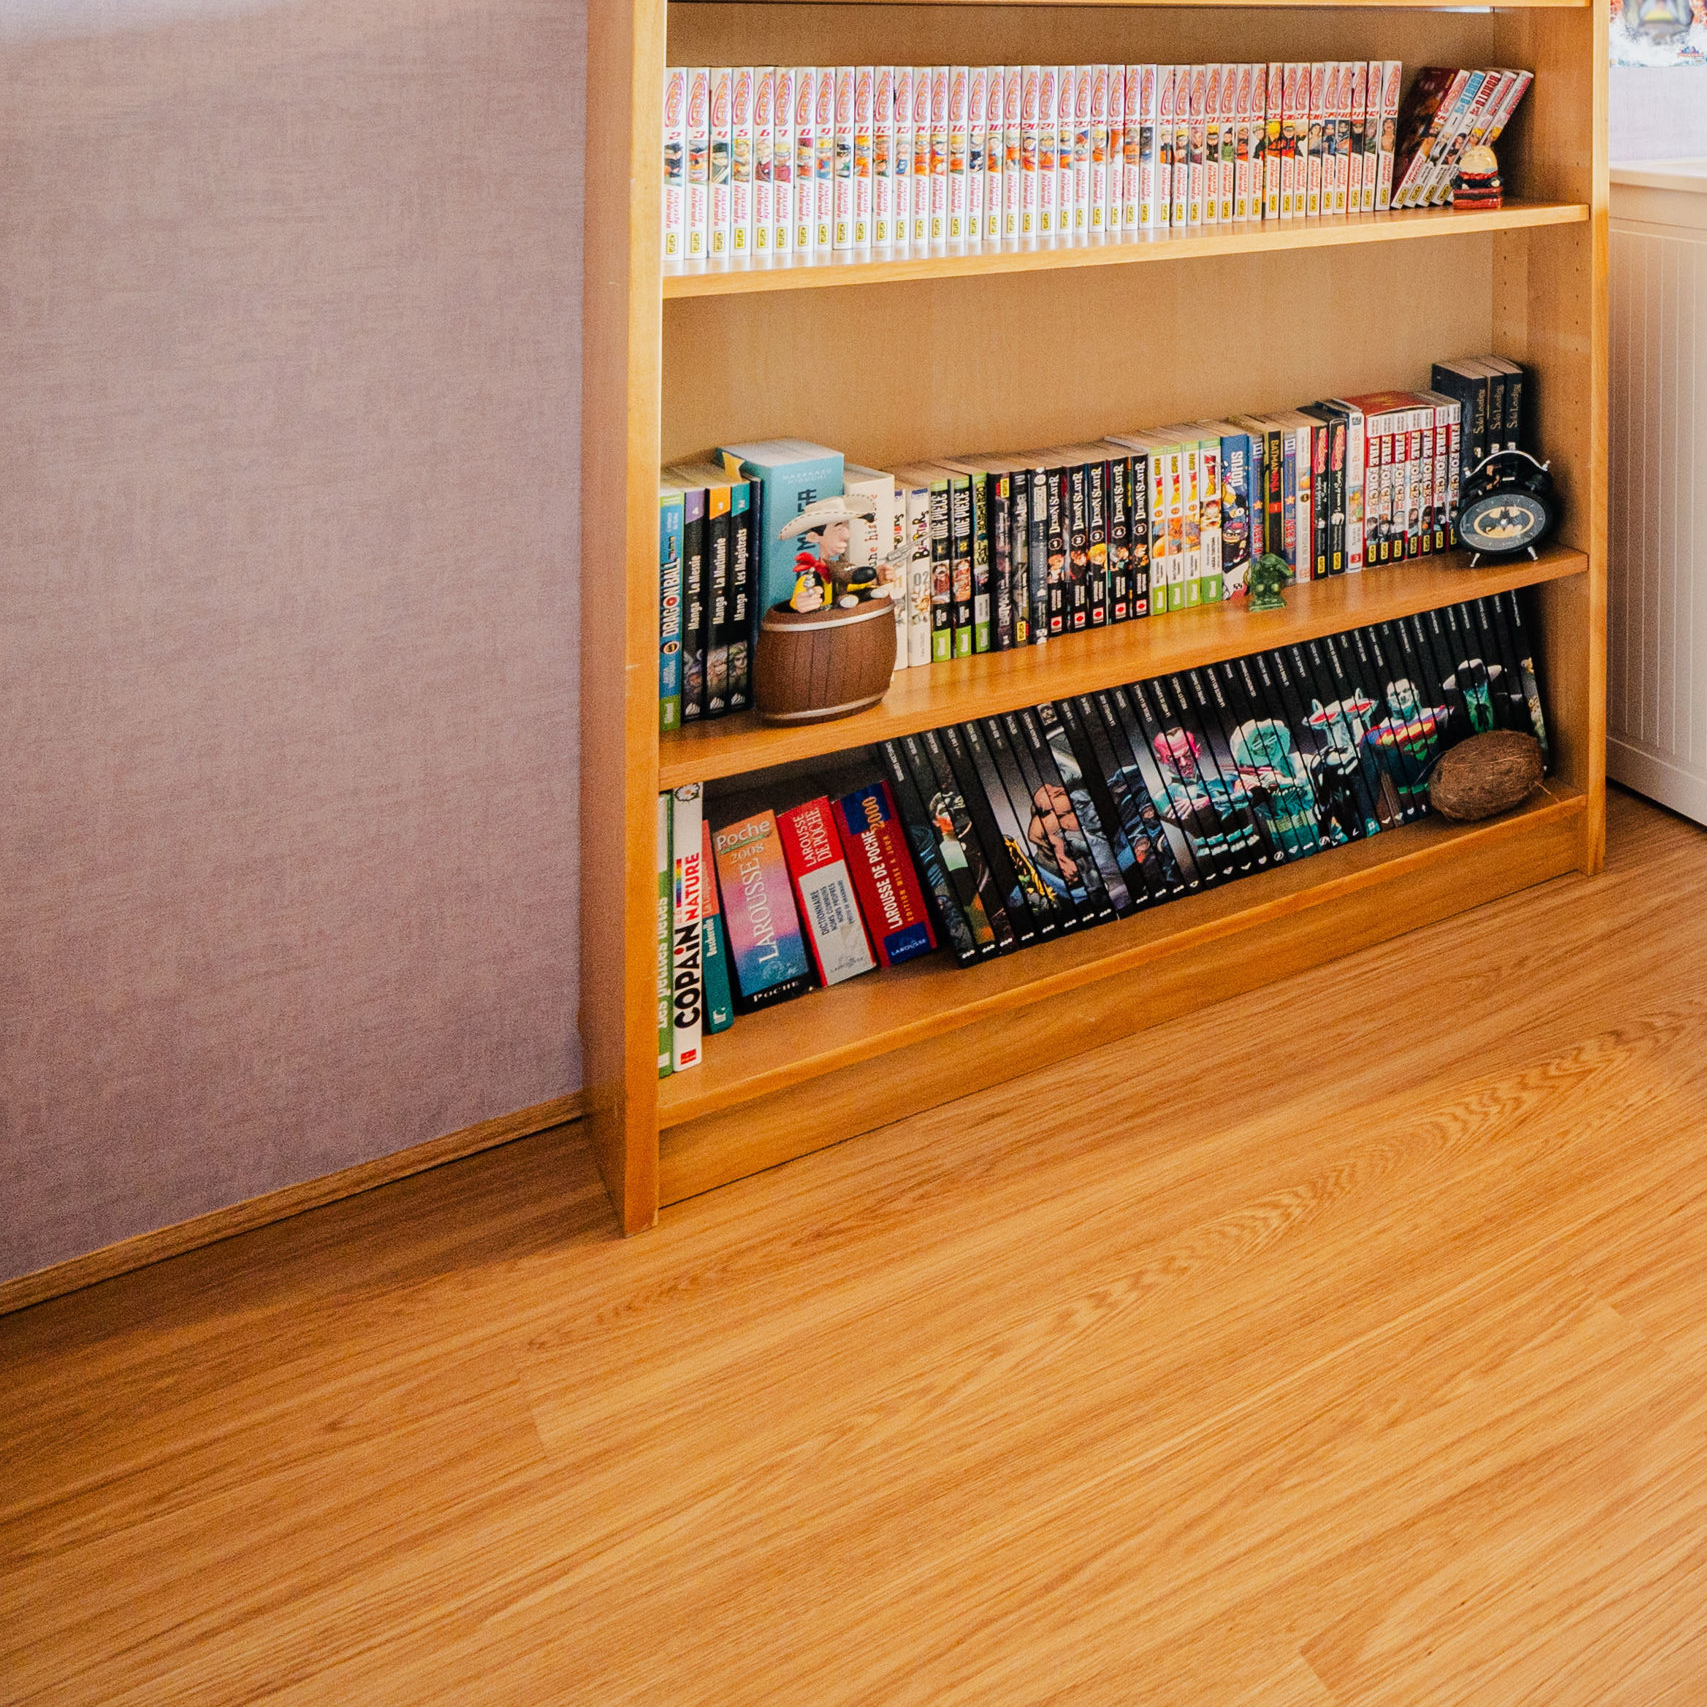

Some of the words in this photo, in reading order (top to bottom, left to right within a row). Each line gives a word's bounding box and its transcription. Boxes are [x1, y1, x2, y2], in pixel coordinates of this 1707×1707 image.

[1475, 74, 1500, 107] BORUTO
[1370, 437, 1379, 466] FIRE
[1382, 435, 1392, 464] FIRE
[1395, 434, 1405, 463] FIRE
[1411, 431, 1420, 460] FIRE
[1423, 429, 1433, 458] FIRE
[1436, 427, 1446, 456] FIRE
[1450, 424, 1460, 452] FIRE
[1368, 467, 1379, 507] FORCE
[1381, 465, 1391, 503] FORCE
[1394, 463, 1405, 502] FORCE
[1410, 460, 1420, 499] FORCE
[1423, 458, 1433, 498] FORCE
[1435, 456, 1446, 494] FORCE
[1449, 452, 1460, 491] FORCE
[954, 490, 970, 517] PIECE
[932, 520, 949, 540] ONE
[954, 517, 970, 538] ONE
[664, 557, 681, 587] BALL
[913, 571, 929, 586] 02
[662, 584, 680, 638] DRAGON
[688, 601, 703, 630] Manga
[713, 595, 728, 625] Manga
[733, 593, 748, 622] Manga
[806, 806, 829, 847] POCHE
[861, 795, 885, 833] 2000
[715, 819, 771, 851] Poche
[793, 813, 817, 867] LAROUSSE
[860, 828, 883, 863] POCHE
[730, 842, 765, 865] 2008
[870, 862, 887, 879] DE
[685, 852, 700, 922] NATURE
[874, 877, 904, 929] LAROUSSE
[739, 857, 780, 964] LAROUSSE
[810, 890, 829, 934] DICTIONNAIRE
